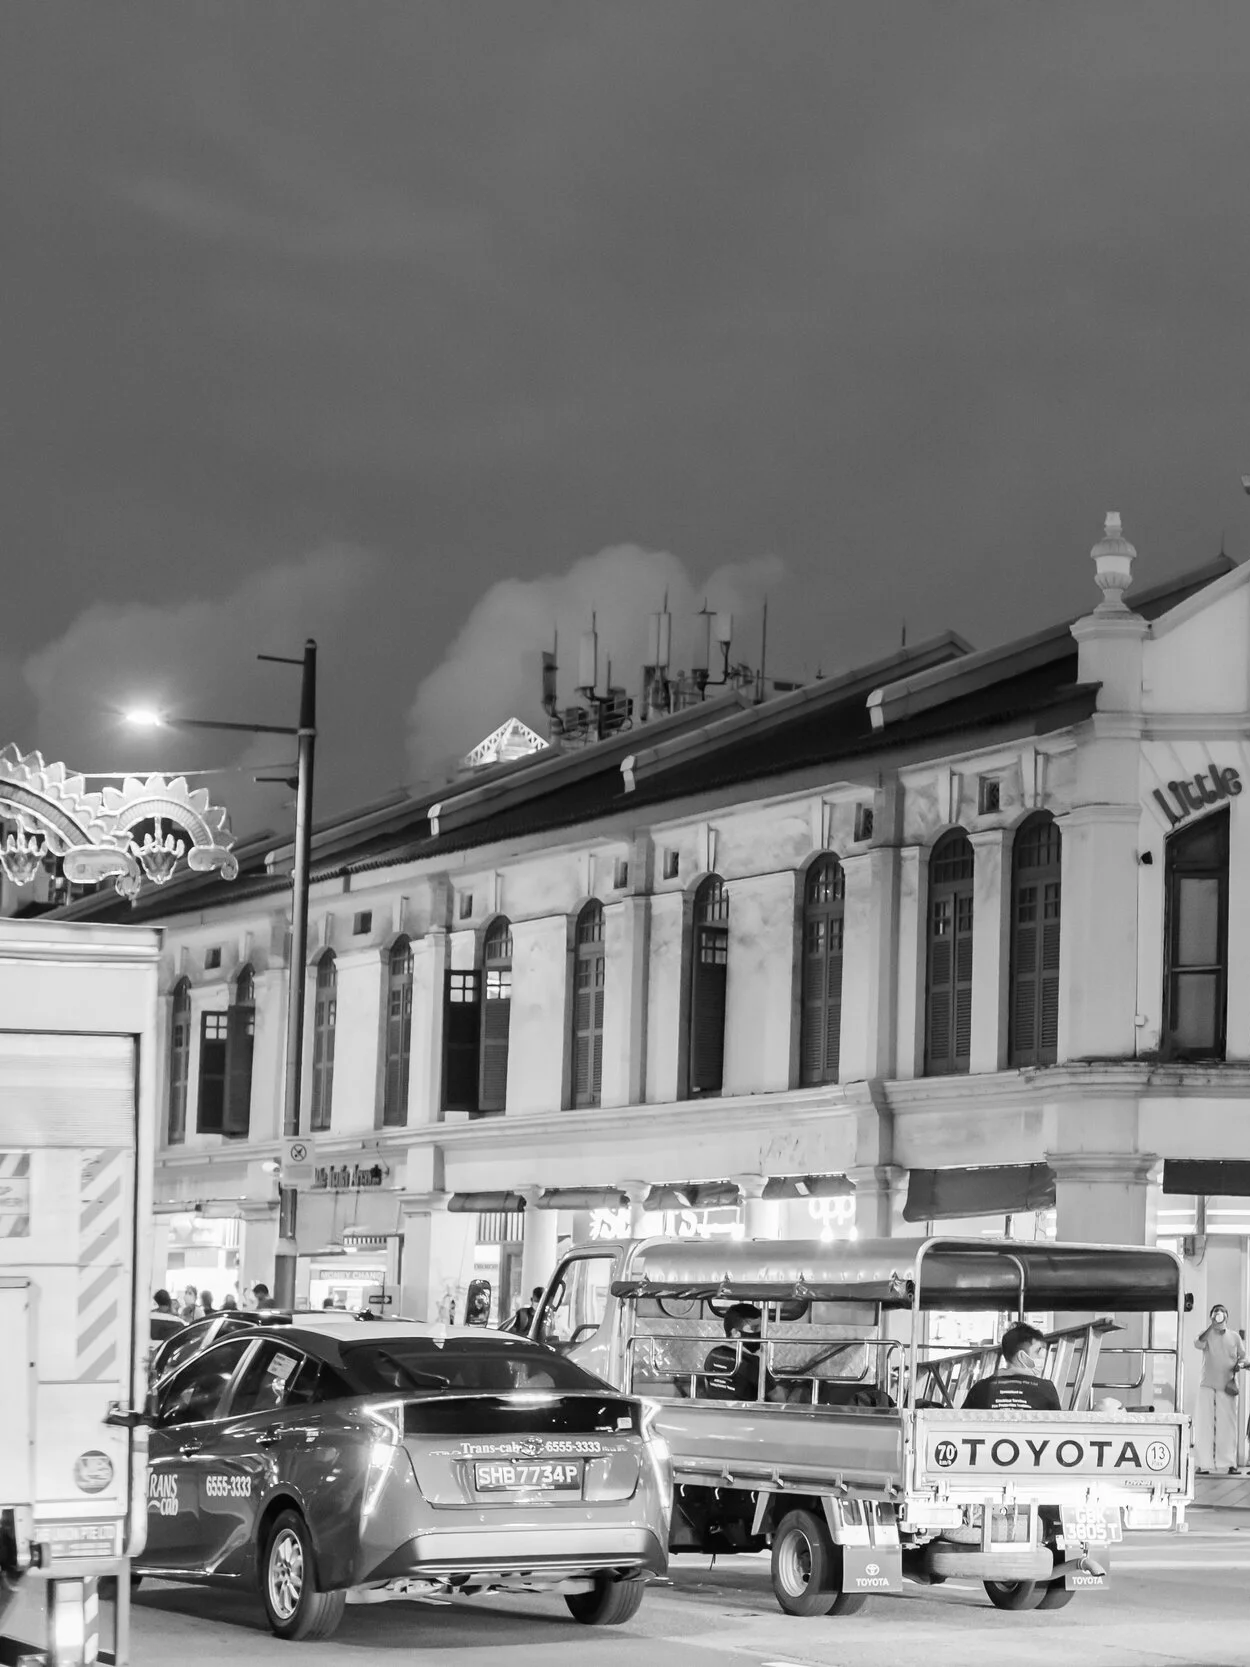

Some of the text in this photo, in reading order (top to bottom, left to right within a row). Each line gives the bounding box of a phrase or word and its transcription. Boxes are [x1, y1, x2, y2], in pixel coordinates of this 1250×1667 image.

[1153, 763, 1242, 828] Little
[545, 1441, 601, 1453] 6555-3333
[937, 1444, 955, 1460] 70
[961, 1438, 1142, 1468] TOYOTA
[1151, 1446, 1165, 1460] 13
[478, 1466, 578, 1484] SHB7734P
[206, 1475, 252, 1497] 6555-3333
[855, 1577, 890, 1587] TOYOTA
[1071, 1576, 1104, 1585] TOYOTA
